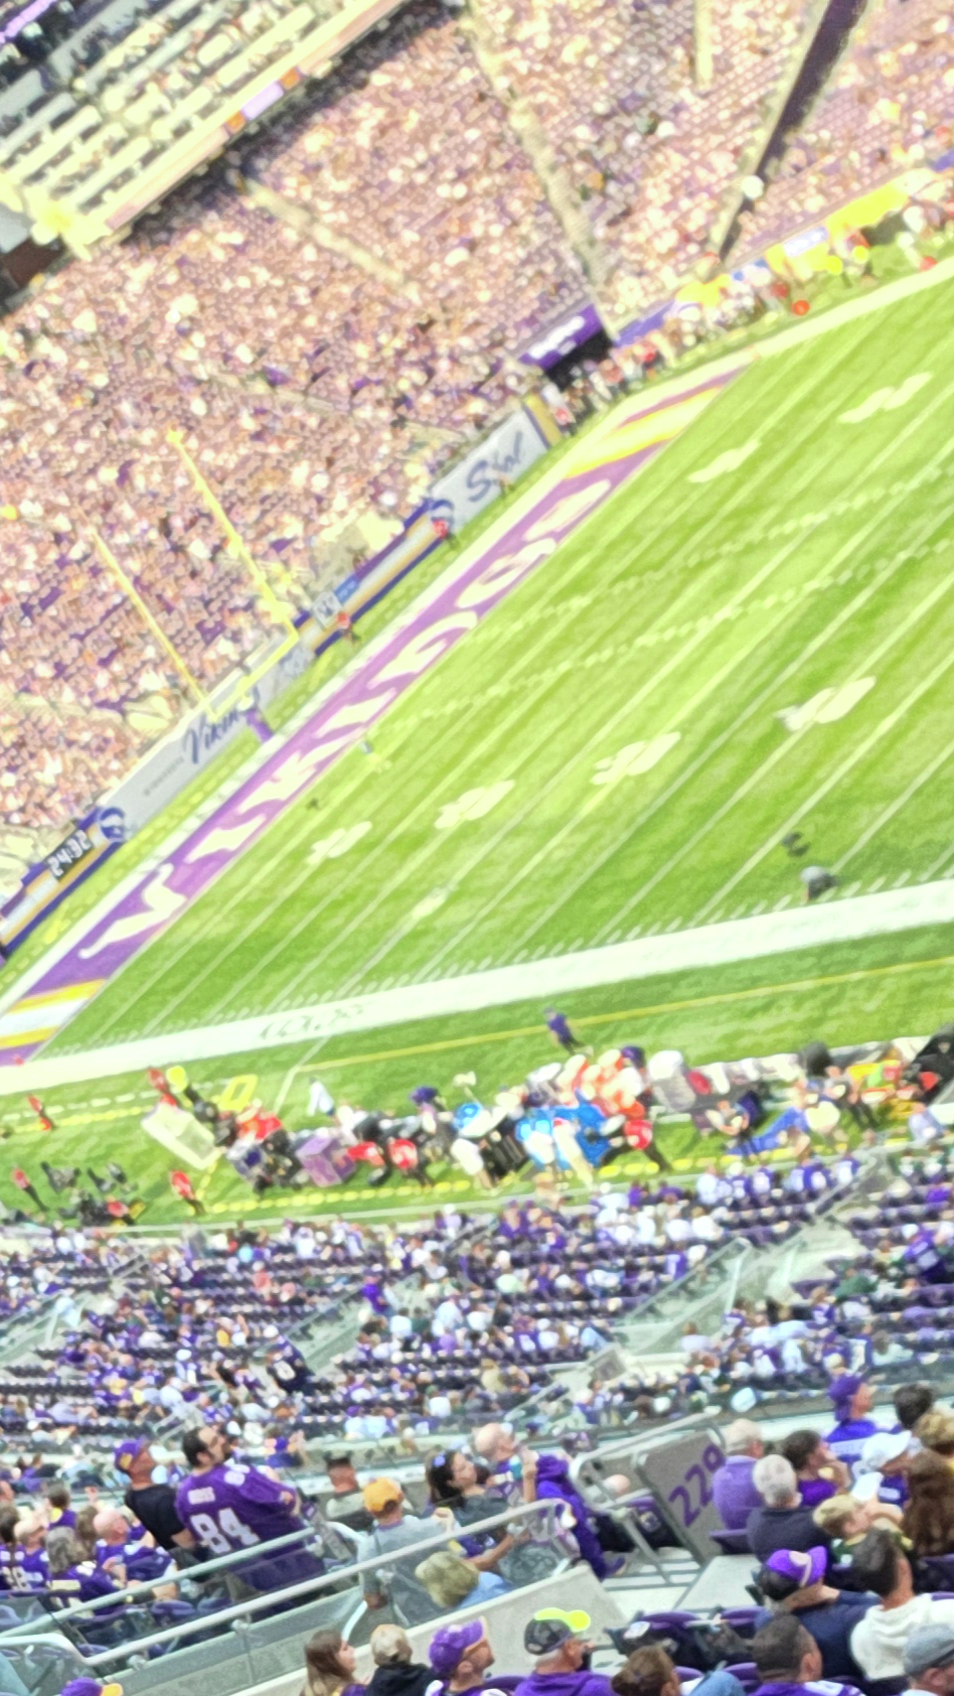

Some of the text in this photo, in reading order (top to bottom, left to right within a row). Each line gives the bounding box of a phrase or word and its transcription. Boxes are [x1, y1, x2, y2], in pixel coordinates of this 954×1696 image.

[77, 478, 613, 960] VIKINGS
[46, 829, 92, 877] 24:32
[189, 1507, 261, 1554] 84
